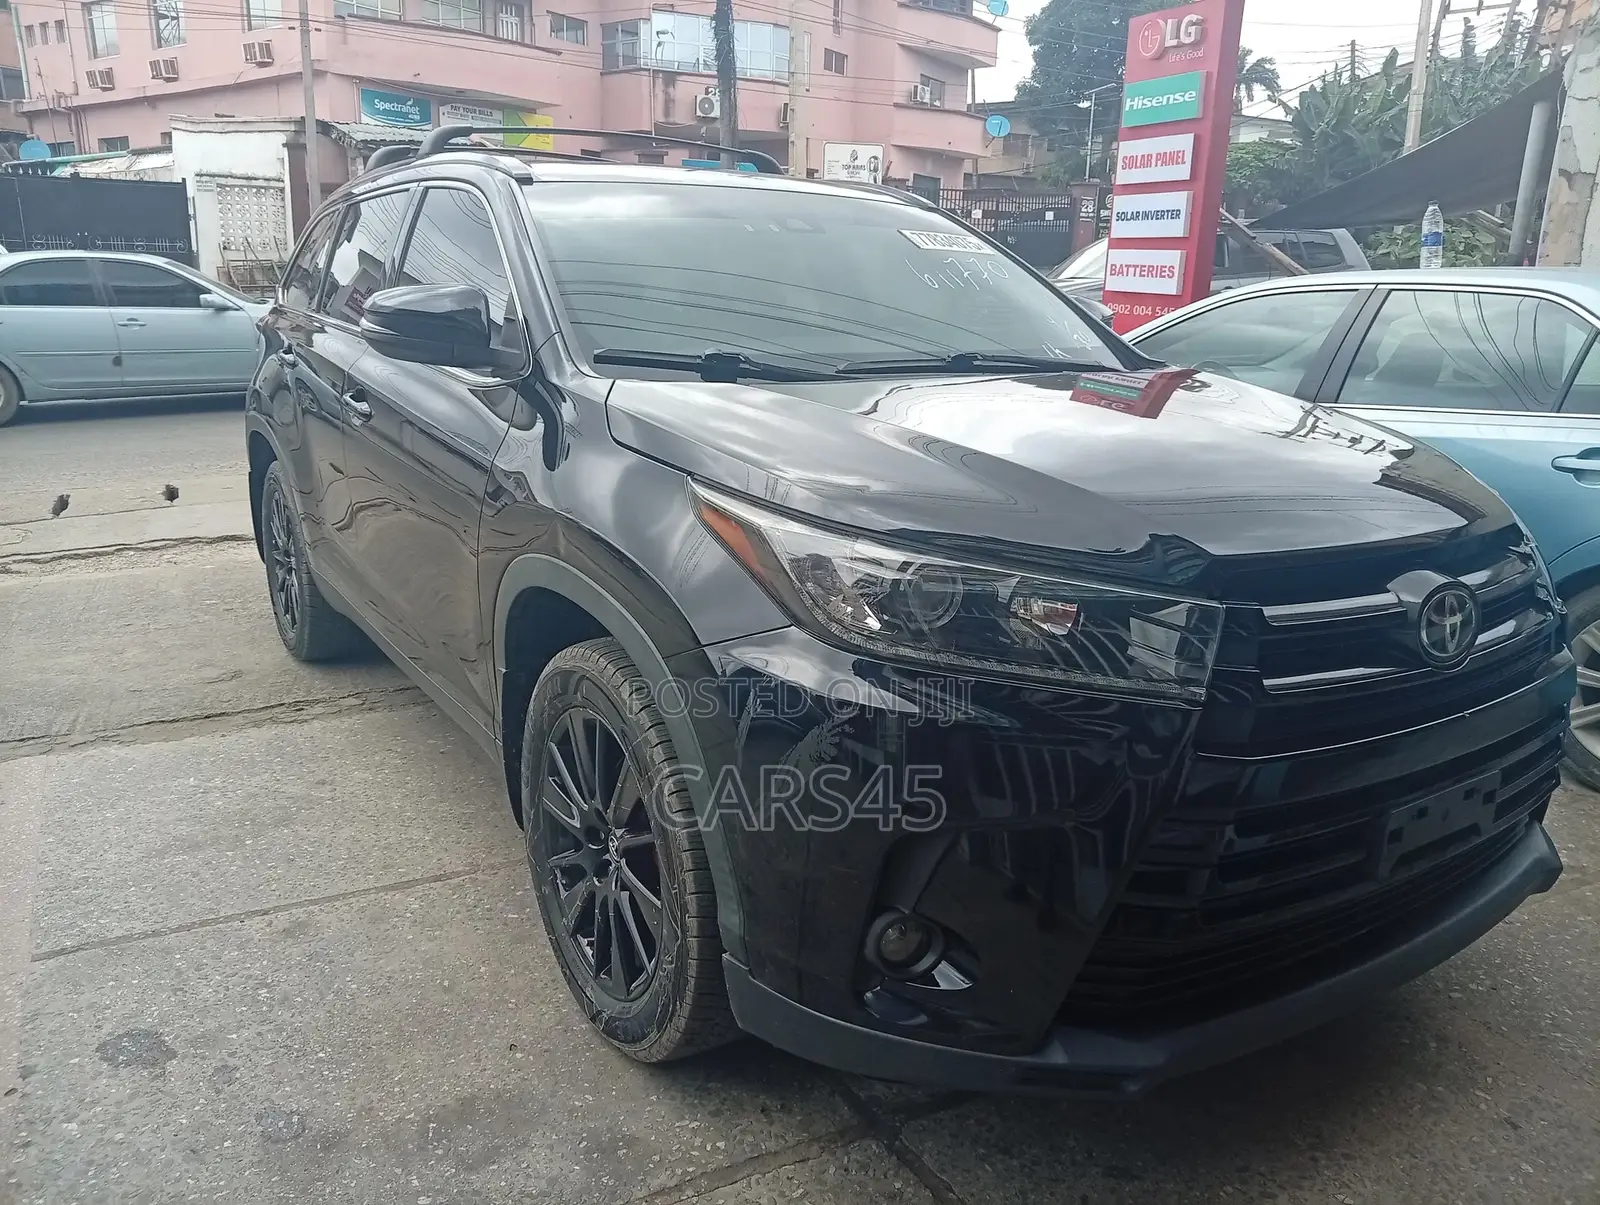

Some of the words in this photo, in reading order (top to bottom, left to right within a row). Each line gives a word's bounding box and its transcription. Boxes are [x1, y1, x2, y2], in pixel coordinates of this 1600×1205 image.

[1164, 13, 1204, 48] LG
[1168, 52, 1186, 63] Life's
[1187, 47, 1204, 60] Good
[374, 98, 420, 115] Spectranet
[1125, 90, 1196, 111] Hisense
[450, 104, 460, 112] PAY
[462, 106, 477, 115] YOUR
[478, 108, 493, 117] BILLS
[1121, 153, 1153, 170] SOLAR
[1154, 149, 1187, 167] PANEL
[1081, 199, 1094, 213] 28
[1115, 211, 1140, 222] SOLAR
[1141, 208, 1182, 221] INVERTER
[1109, 263, 1175, 279] BATTERIES
[1107, 302, 1130, 315] 0902
[1133, 305, 1152, 316] 004
